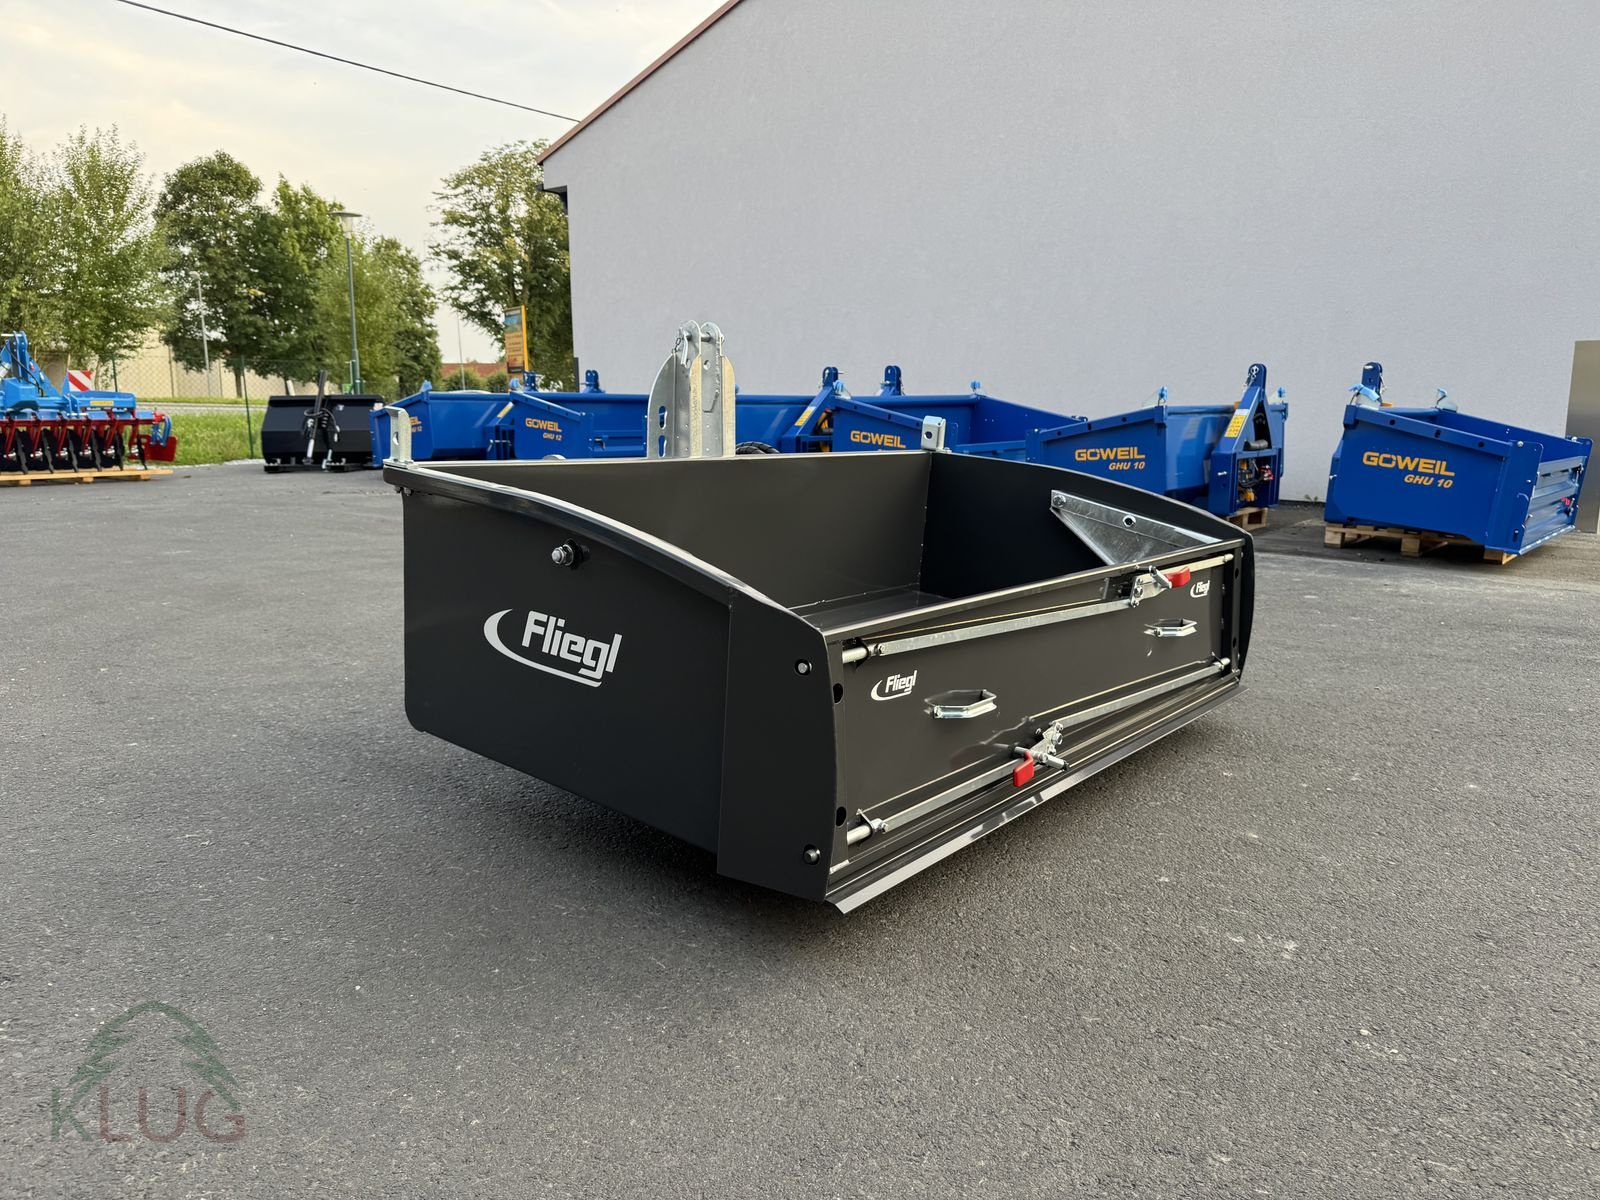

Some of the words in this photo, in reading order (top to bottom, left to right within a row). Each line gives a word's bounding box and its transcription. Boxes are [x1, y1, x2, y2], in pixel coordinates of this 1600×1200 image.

[1109, 461, 1131, 470] GHU
[1133, 461, 1146, 470] 10
[1404, 474, 1434, 486] GHU
[1437, 479, 1453, 489] 10
[1195, 580, 1210, 596] Fliegl
[521, 610, 623, 680] Fliegl
[885, 669, 918, 693] Fliegl
